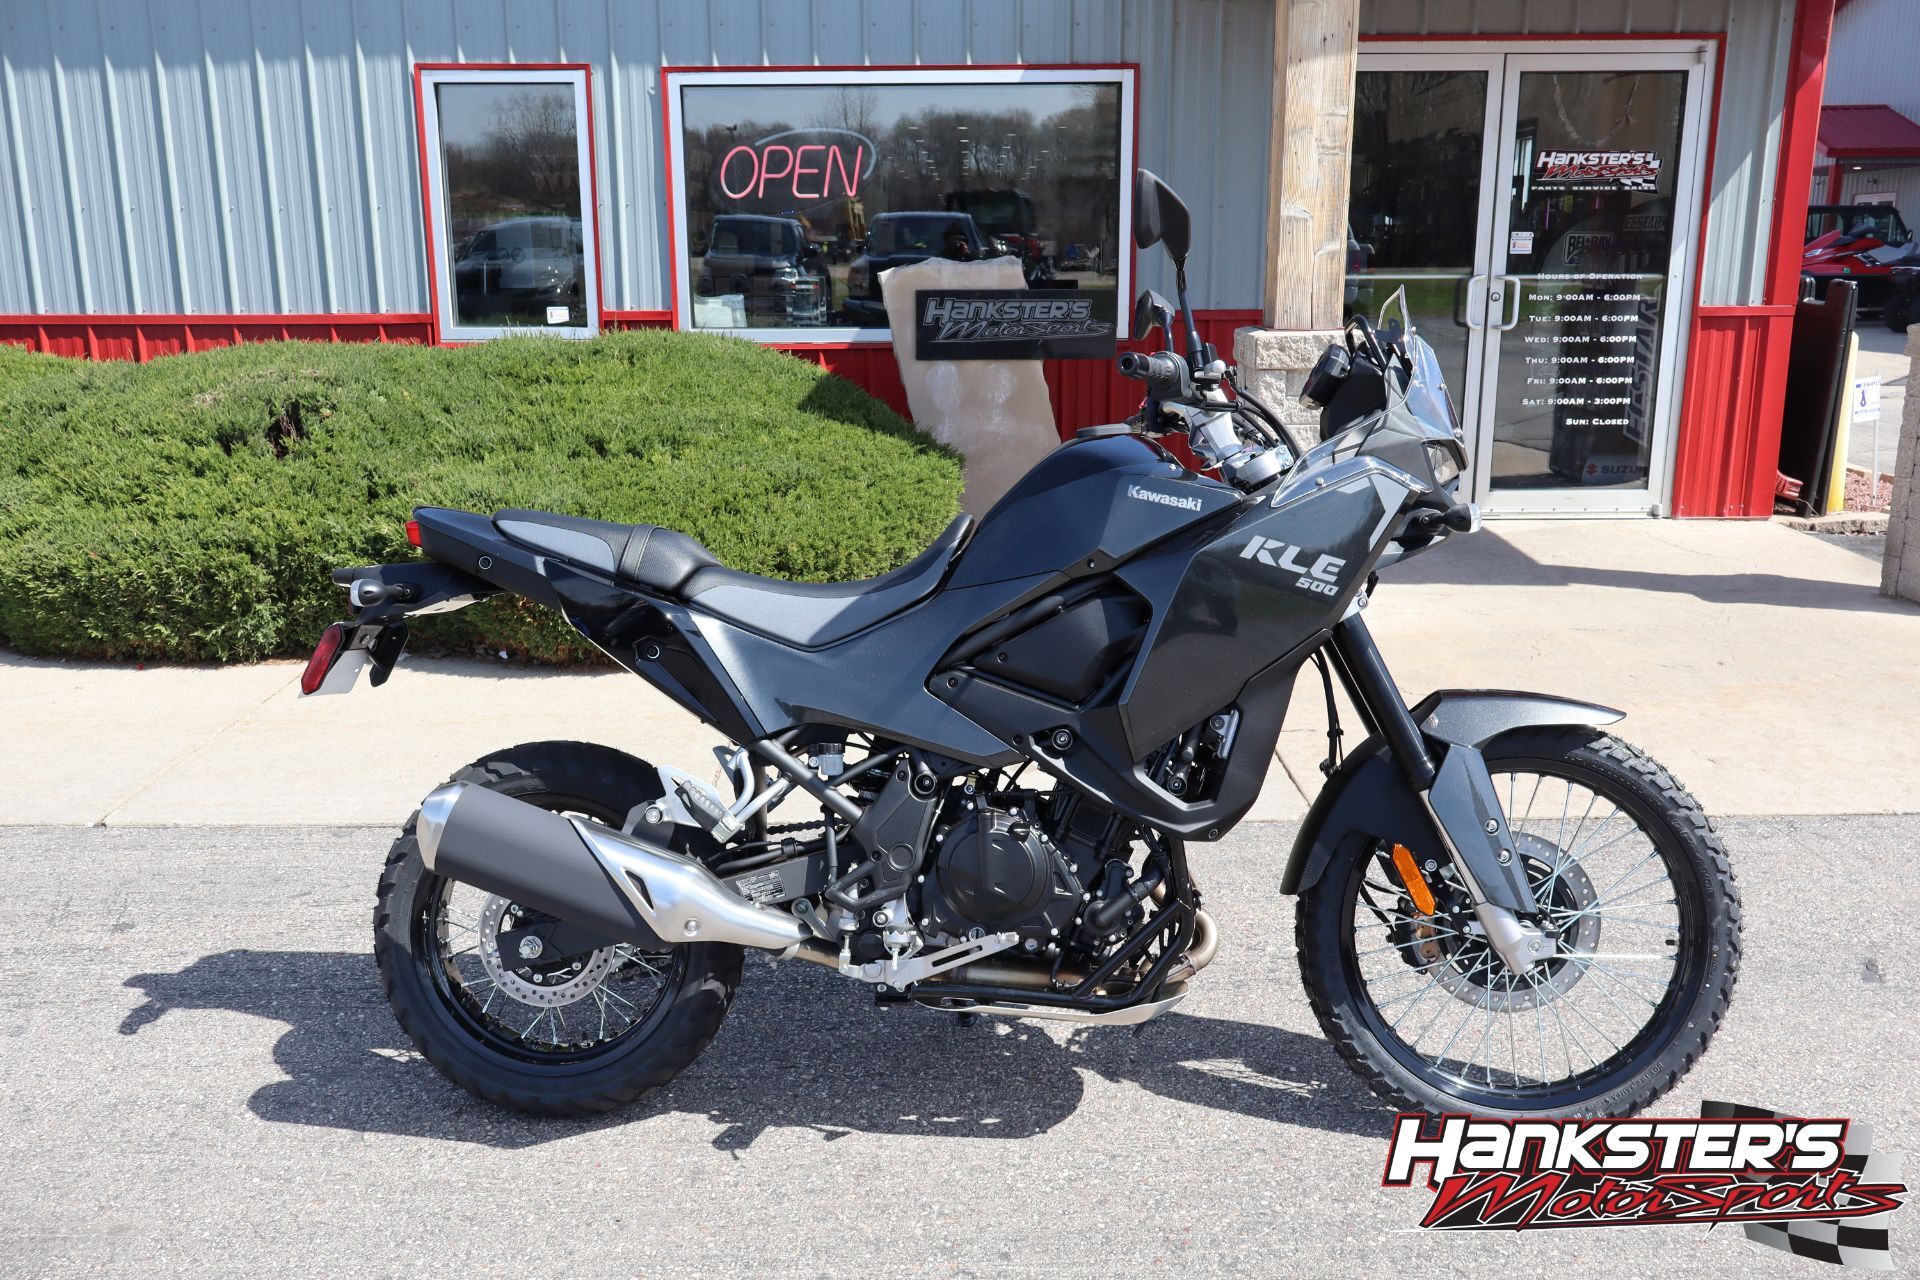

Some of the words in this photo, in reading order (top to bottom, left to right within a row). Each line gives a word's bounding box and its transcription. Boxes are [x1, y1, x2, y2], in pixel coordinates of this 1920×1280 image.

[720, 145, 863, 199] OPEN
[1127, 484, 1202, 512] Kawasaki
[1239, 535, 1347, 583] KLE
[1295, 577, 1339, 597] 500
